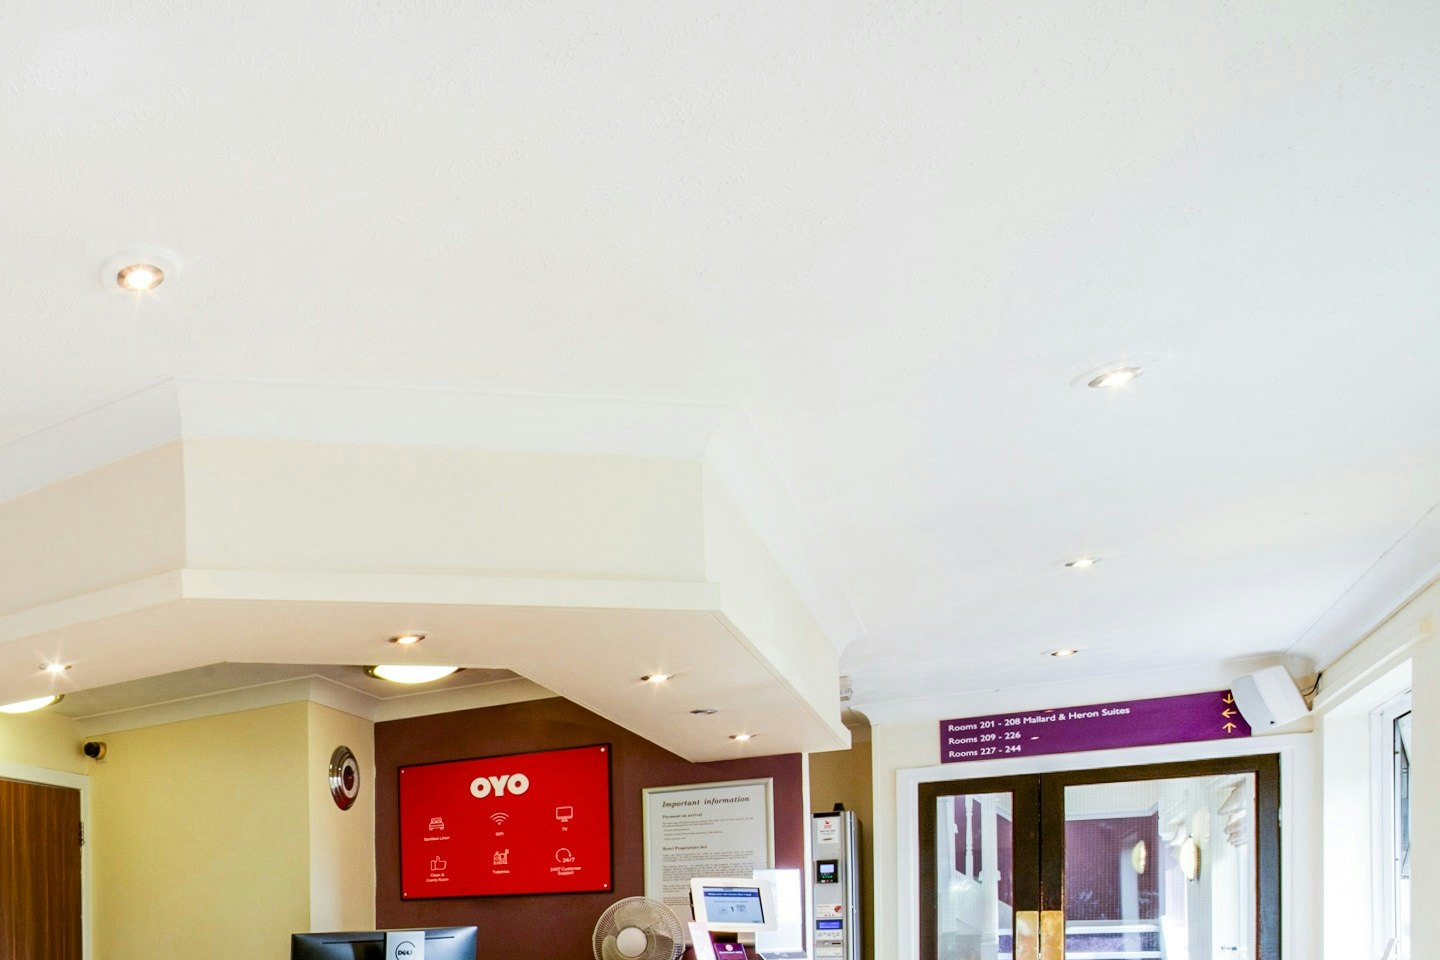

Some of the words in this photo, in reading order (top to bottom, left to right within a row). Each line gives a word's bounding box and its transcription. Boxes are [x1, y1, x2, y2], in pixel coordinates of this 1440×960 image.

[948, 724, 977, 732] Rooms
[980, 720, 995, 729] 201
[1004, 718, 1021, 726] 208
[1023, 714, 1056, 724] Mallard
[1068, 710, 1099, 720] Heron
[1101, 707, 1130, 716] Suites
[948, 737, 978, 745] Rooms
[980, 733, 996, 742] 209
[1004, 731, 1021, 740] 226
[948, 750, 978, 758] Rooms
[980, 747, 996, 755] 227
[1005, 745, 1021, 753] 244
[469, 773, 530, 799] OYO
[662, 800, 700, 808] Important
[703, 796, 750, 805] information
